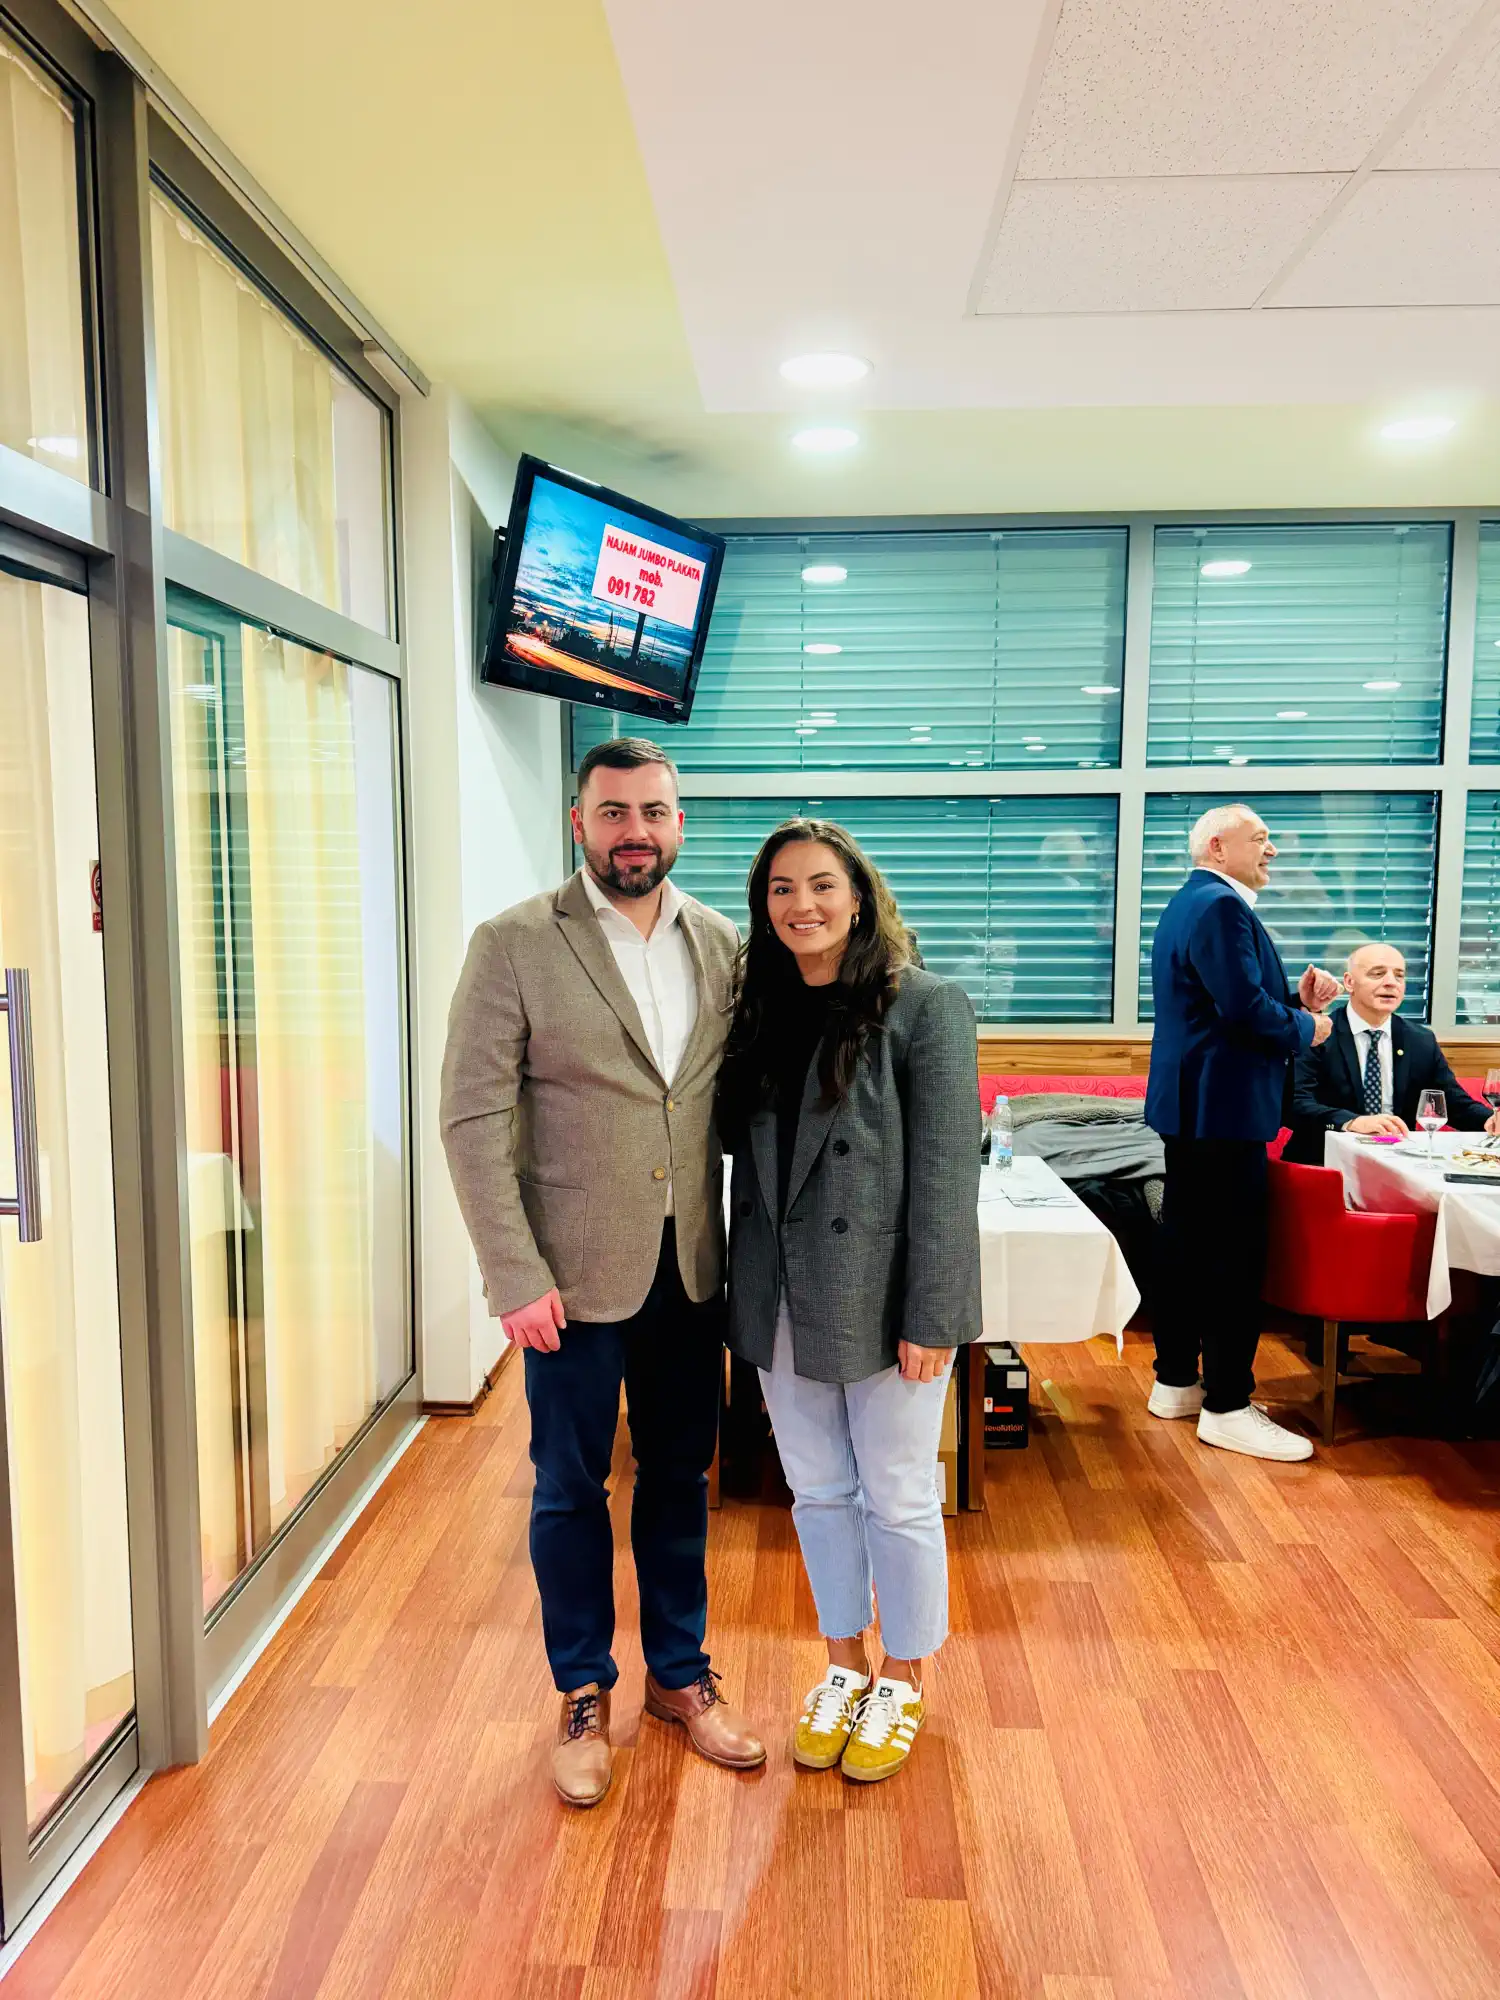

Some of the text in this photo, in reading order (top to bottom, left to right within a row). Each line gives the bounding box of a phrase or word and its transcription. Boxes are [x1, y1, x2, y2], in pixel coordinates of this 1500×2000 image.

[606, 535, 700, 581] NAJAM JUMBO PLAKATA
[607, 576, 656, 608] 091 782
[639, 568, 663, 588] mob.
